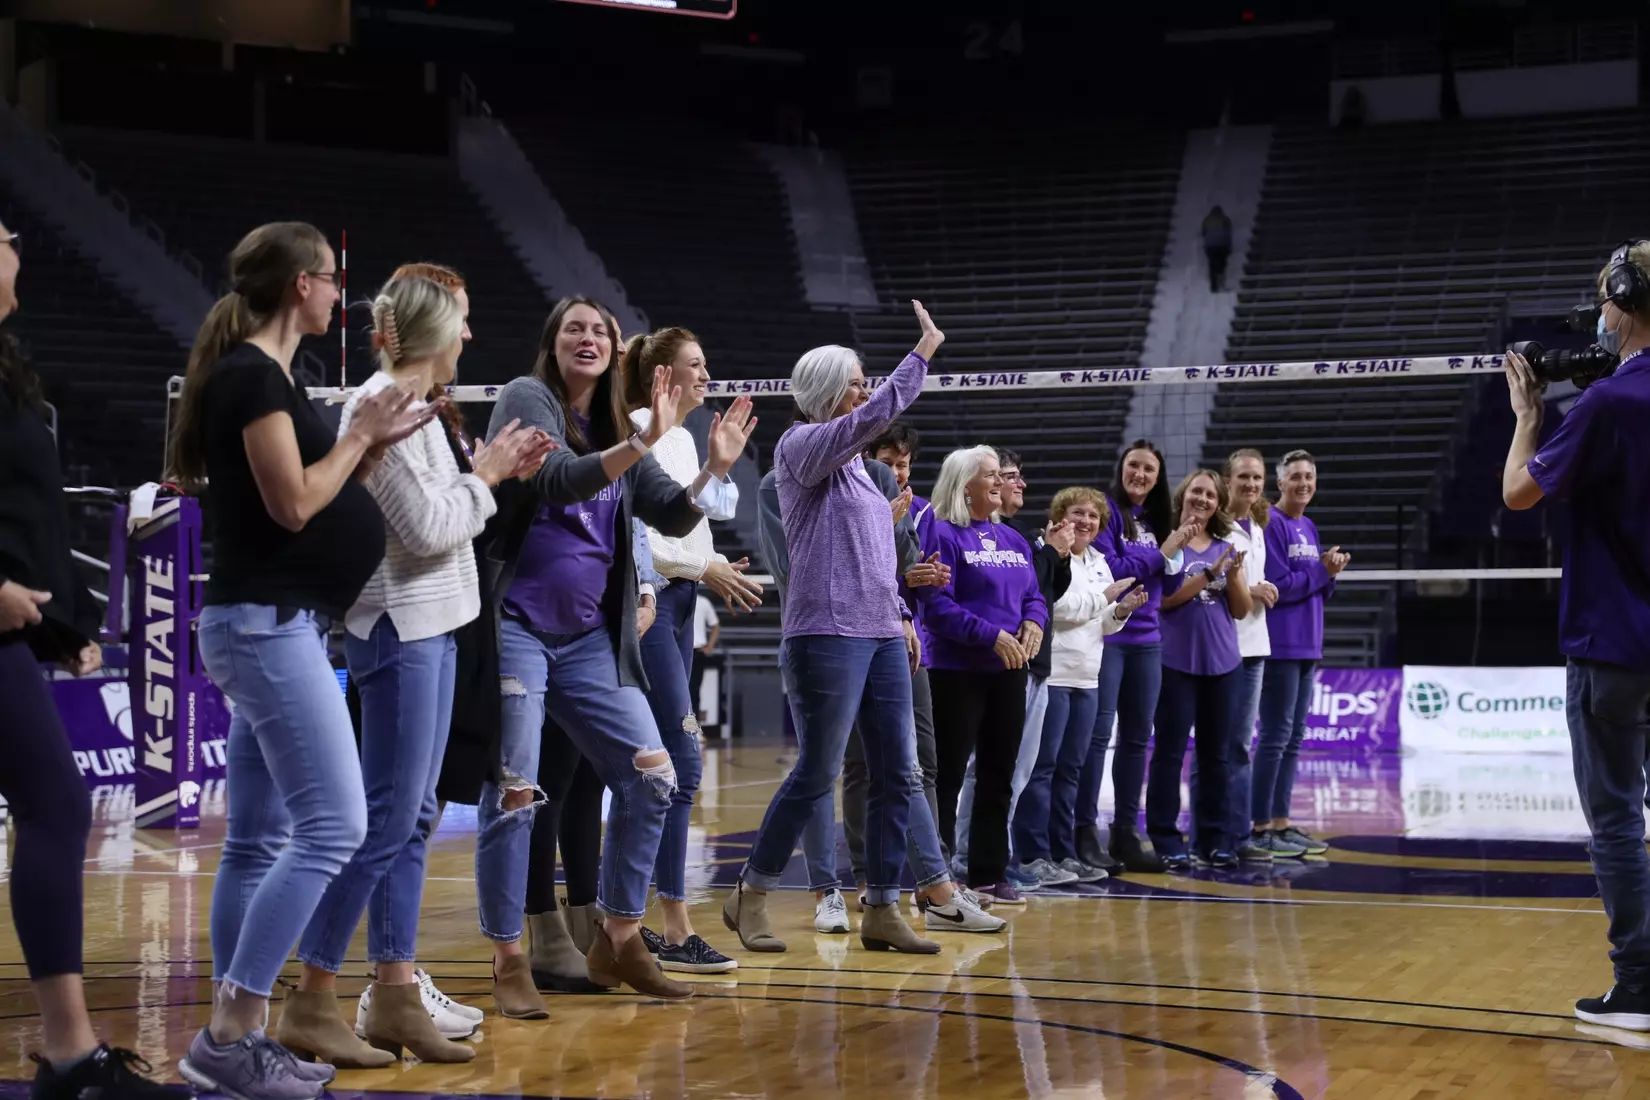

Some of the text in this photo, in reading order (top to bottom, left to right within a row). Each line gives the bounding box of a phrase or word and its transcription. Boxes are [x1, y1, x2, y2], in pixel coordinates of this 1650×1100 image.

[963, 21, 1024, 59] 24
[1207, 364, 1280, 379] K-STATE
[1336, 359, 1413, 374] K-STATE
[959, 373, 1028, 387] K-STATE
[1080, 368, 1152, 383] K-STATE
[726, 380, 790, 393] K-STATE
[964, 550, 1028, 565] K-STATE
[973, 561, 1028, 569] VOLLEYBALL
[144, 555, 174, 773] K-STATE
[1308, 682, 1378, 725] lips
[1457, 692, 1564, 713] Comme
